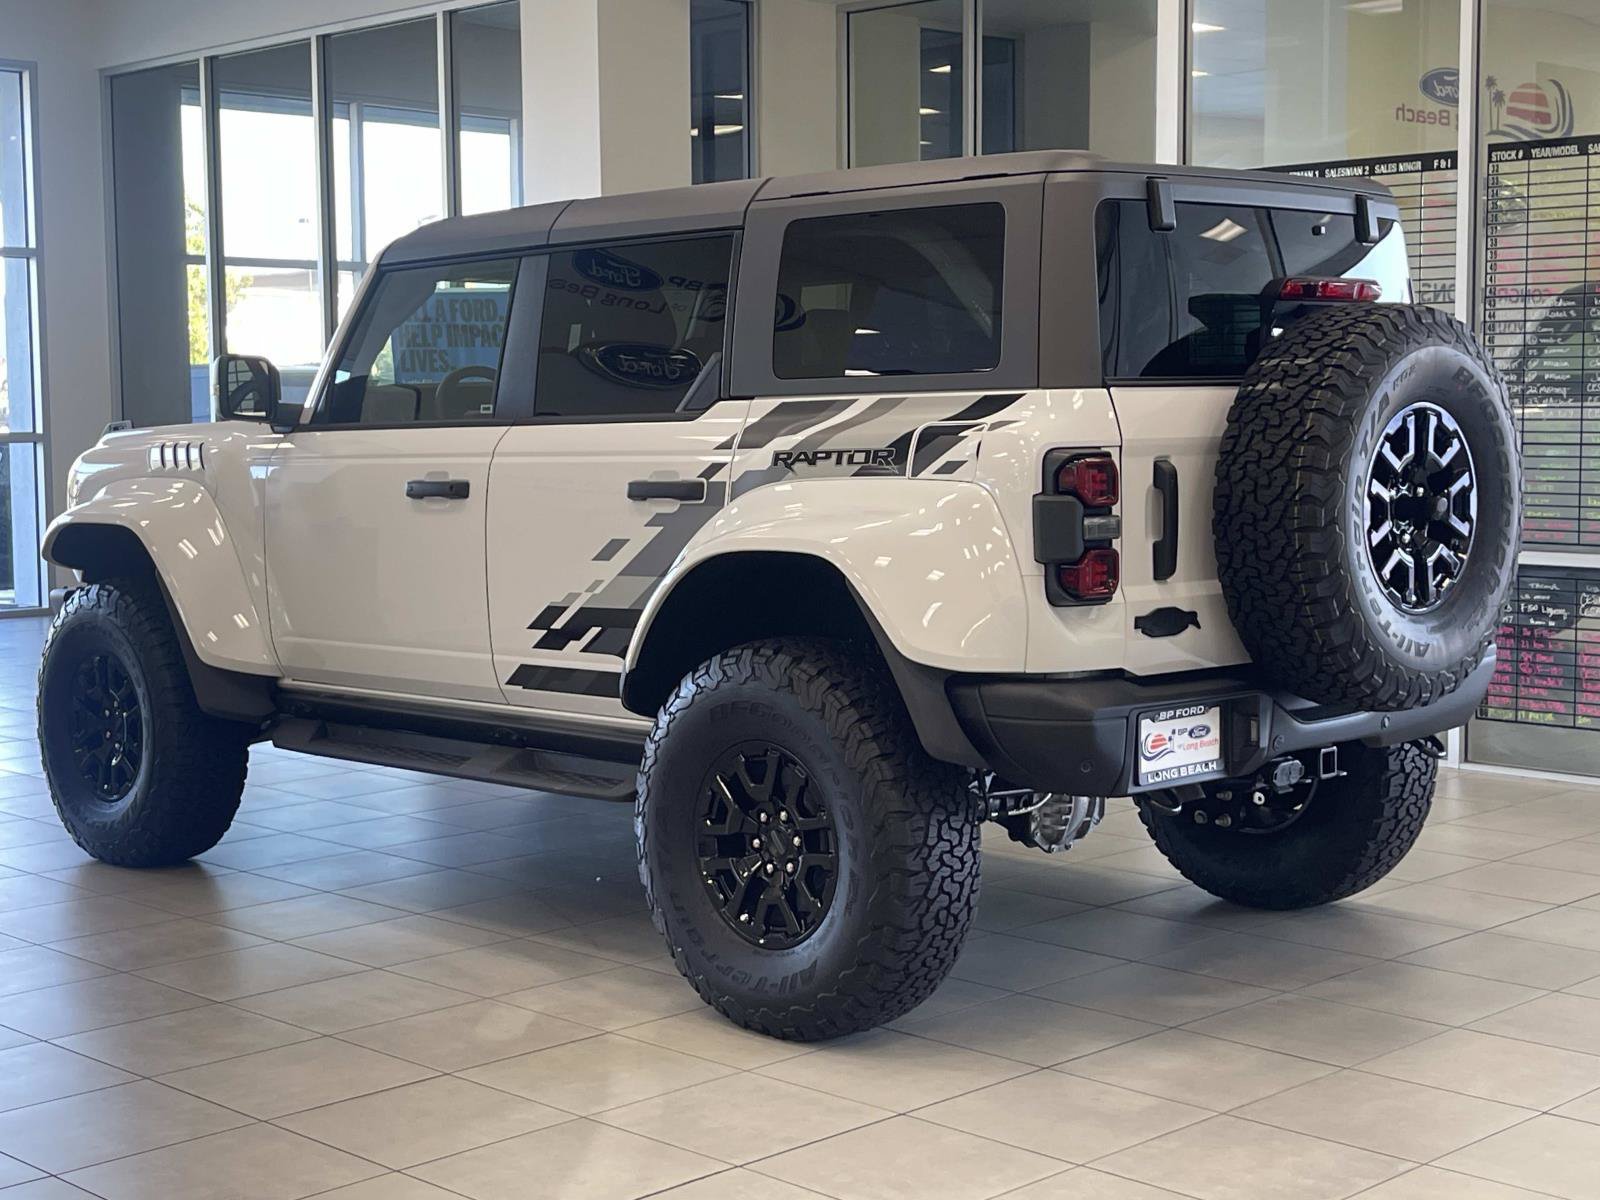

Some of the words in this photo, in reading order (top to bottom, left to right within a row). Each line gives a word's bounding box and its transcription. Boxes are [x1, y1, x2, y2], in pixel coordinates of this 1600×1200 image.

[1491, 150, 1516, 161] STOCK
[1531, 145, 1579, 158] YEAR/MODEL
[1325, 166, 1363, 178] SALESMAN
[1365, 166, 1370, 175] 2
[1374, 163, 1397, 174] SALES
[1434, 160, 1439, 169] F
[1440, 160, 1447, 168] &
[1490, 238, 1497, 247] 38
[1489, 250, 1497, 259] 39
[1489, 263, 1497, 272] 40
[1488, 274, 1496, 283] 41
[1488, 287, 1496, 296] 42
[1488, 298, 1496, 308] 43
[1487, 311, 1496, 320] 44
[773, 449, 898, 475] RAPTOR
[1351, 473, 1431, 658] All-Terrain
[1160, 711, 1174, 720] BP
[1176, 706, 1204, 717] FORD
[1191, 727, 1207, 737] Ford
[1183, 742, 1198, 752] Long
[1200, 738, 1218, 748] Beach
[1148, 771, 1178, 782] LONG
[1180, 761, 1217, 777] BEACH
